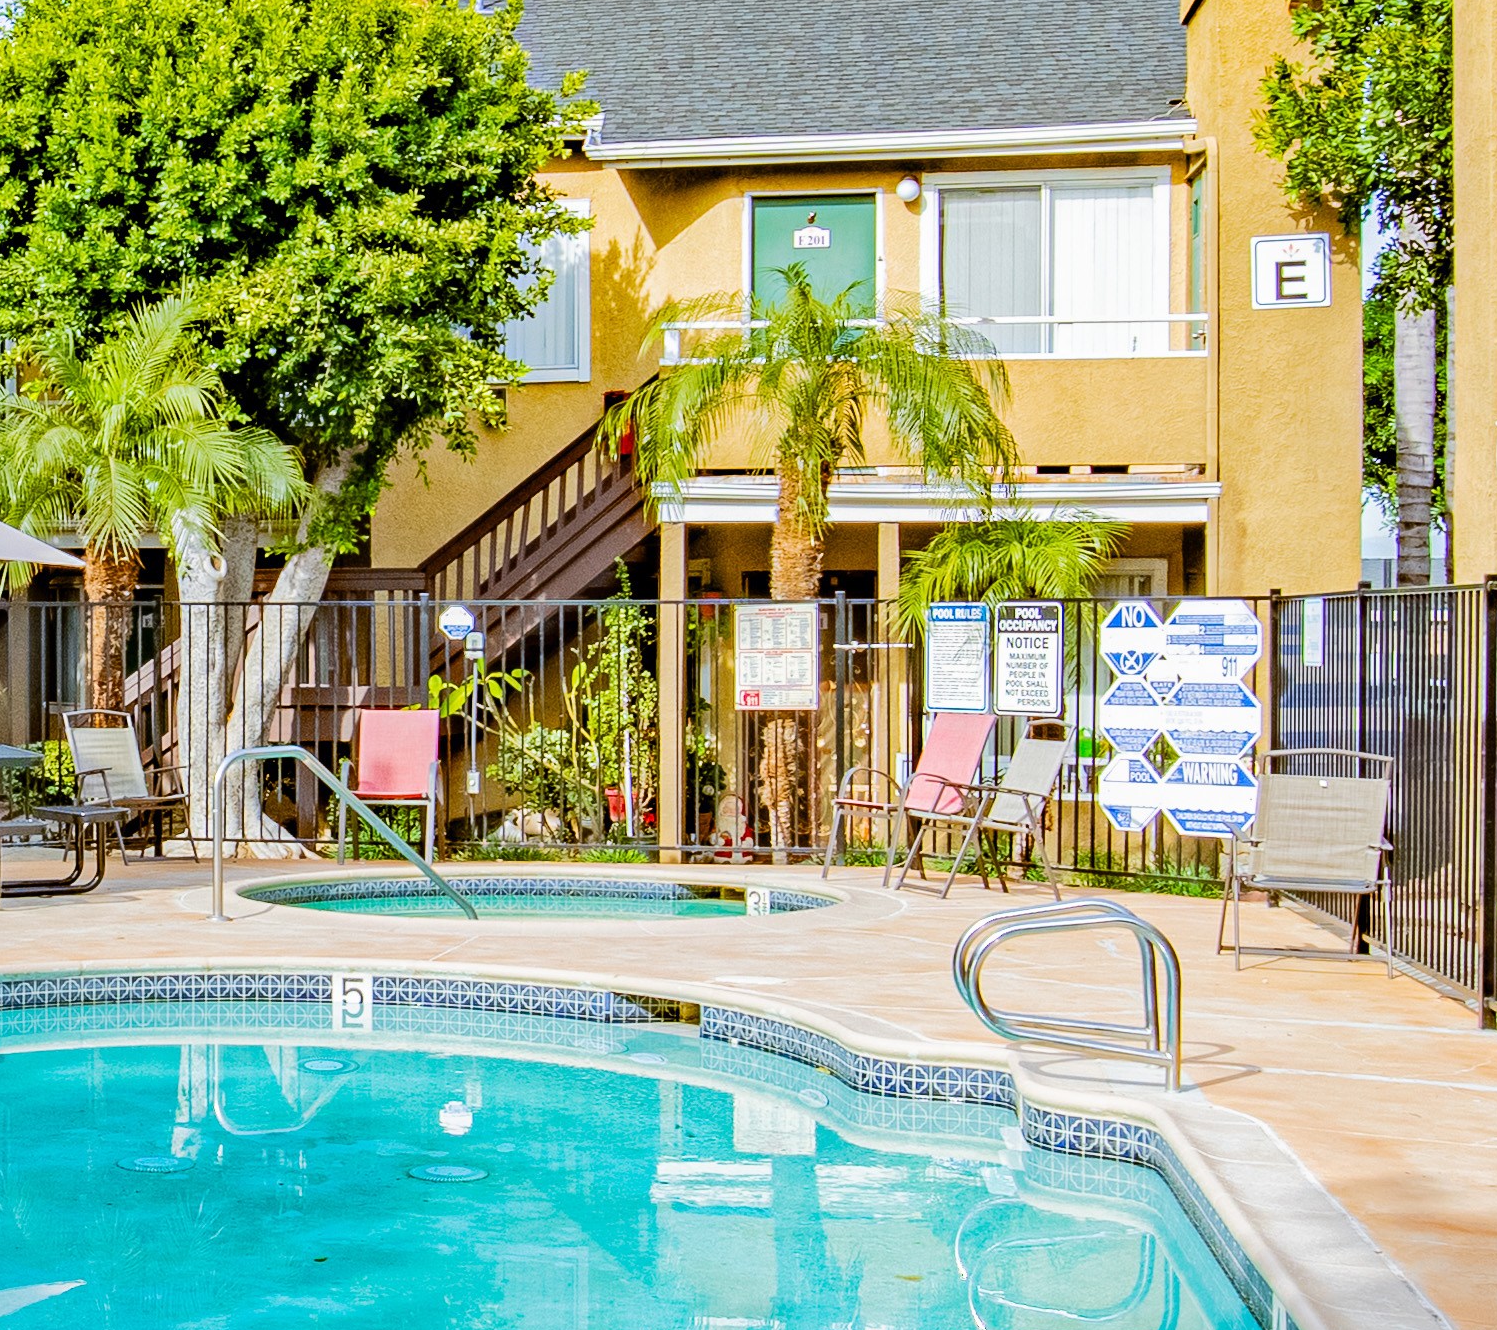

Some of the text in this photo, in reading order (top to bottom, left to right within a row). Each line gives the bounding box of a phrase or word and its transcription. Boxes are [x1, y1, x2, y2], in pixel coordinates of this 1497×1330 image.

[1275, 260, 1308, 301] E
[932, 608, 982, 620] POOL RULES
[1015, 607, 1042, 619] POOL
[1121, 605, 1146, 628] NO
[999, 619, 1058, 632] OCCUPANCY
[1006, 637, 1049, 649] NOTICE
[1005, 662, 1049, 670] NUMBER OF
[1222, 656, 1238, 678] 911
[1009, 670, 1046, 679] PEOPLE IN
[1006, 679, 1049, 689] POOL SHALL
[1005, 689, 1049, 698] NOT EXCEED
[1017, 698, 1051, 707] PERSONS
[1130, 771, 1152, 783] POOL
[1182, 761, 1238, 786] WARNING
[342, 977, 364, 1004] 5
